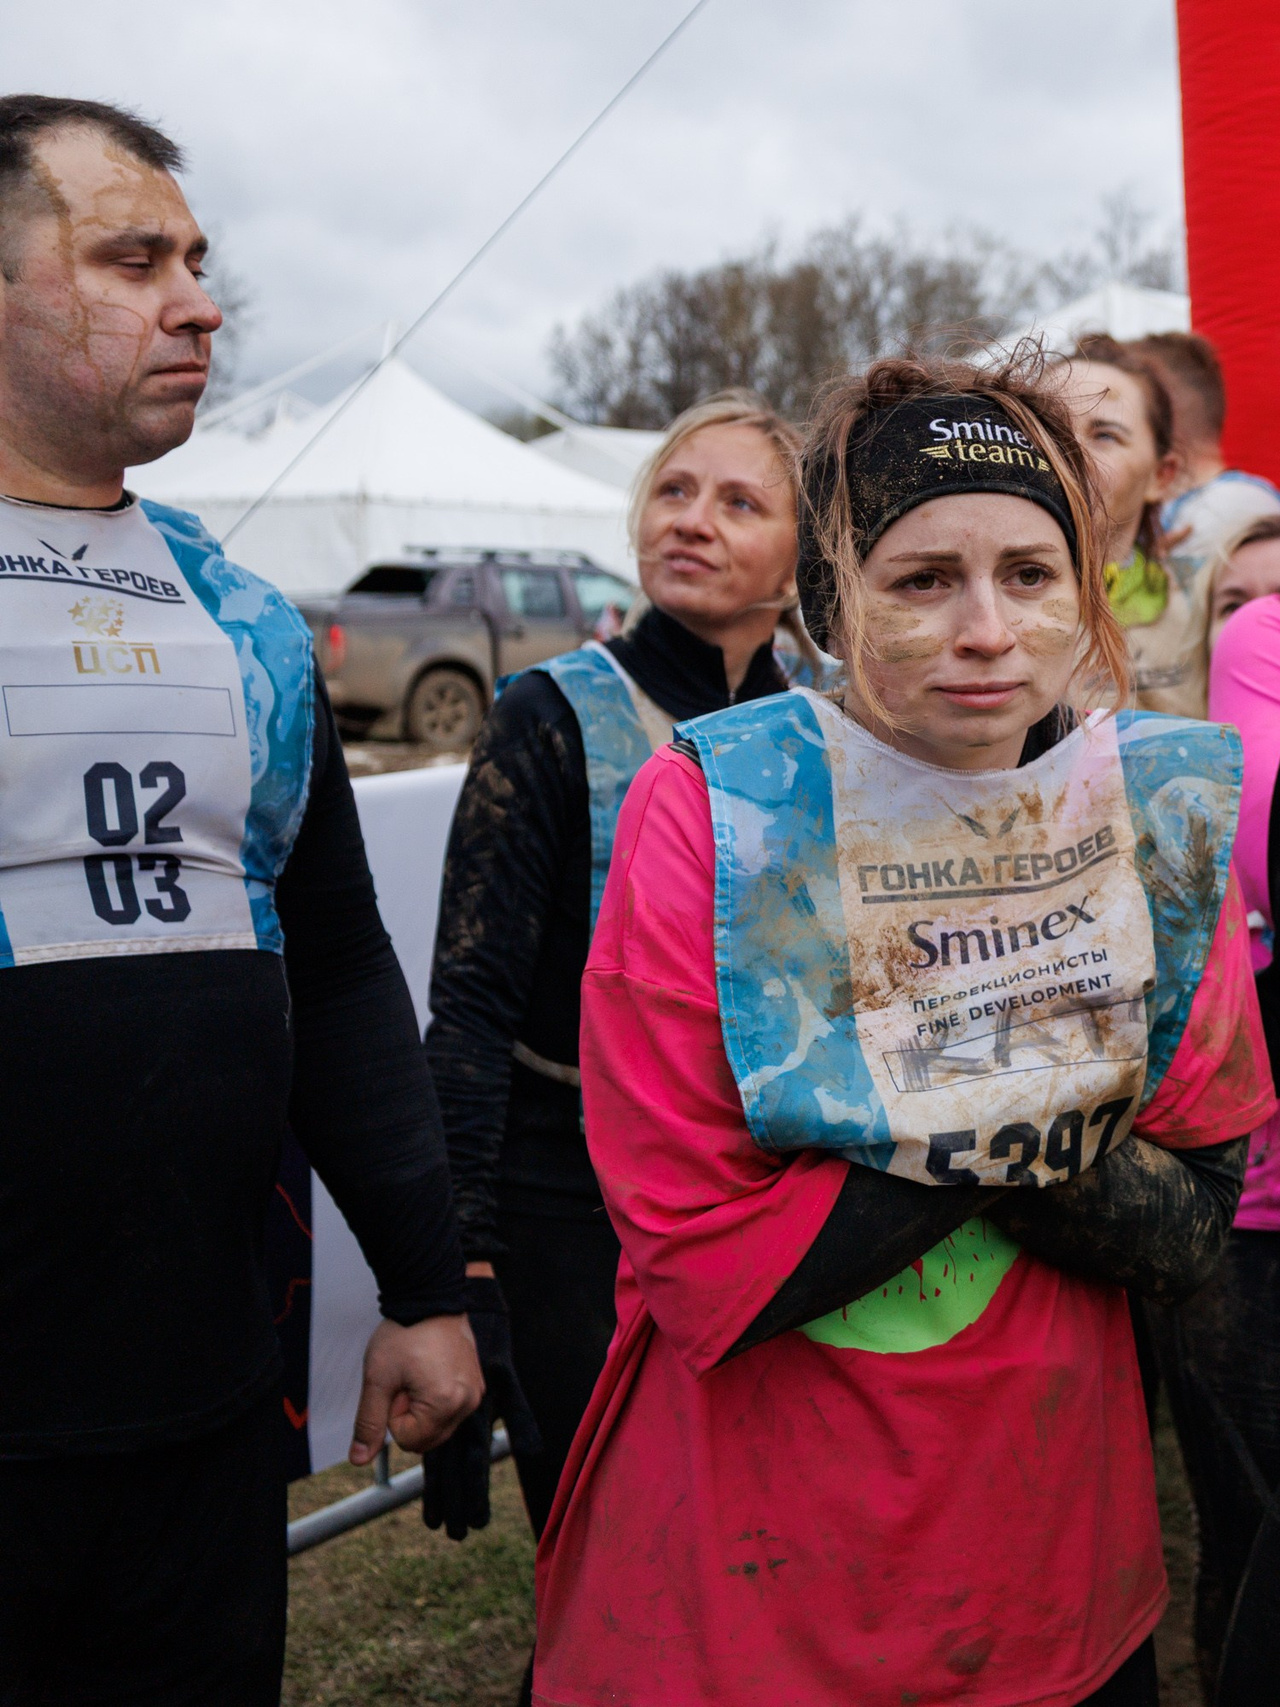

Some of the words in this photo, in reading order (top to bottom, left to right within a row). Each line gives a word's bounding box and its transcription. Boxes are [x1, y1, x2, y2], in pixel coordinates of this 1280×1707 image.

[928, 417, 1034, 449] Smine
[953, 439, 1035, 469] team
[0, 554, 73, 578] НКА
[75, 566, 182, 598] ГЕРОЕВ
[72, 643, 161, 676] ЦСП
[83, 761, 187, 847] 02
[83, 853, 192, 926] 03
[857, 858, 980, 893] ГОНКА
[993, 823, 1117, 883] ГЕРОЕВ
[908, 895, 1098, 969] Sminex
[912, 948, 1109, 1013] ПЕРФЕКЦИОНИСТЫ
[916, 1013, 962, 1037] FINE
[969, 974, 1113, 1021] DEVELOPMENT
